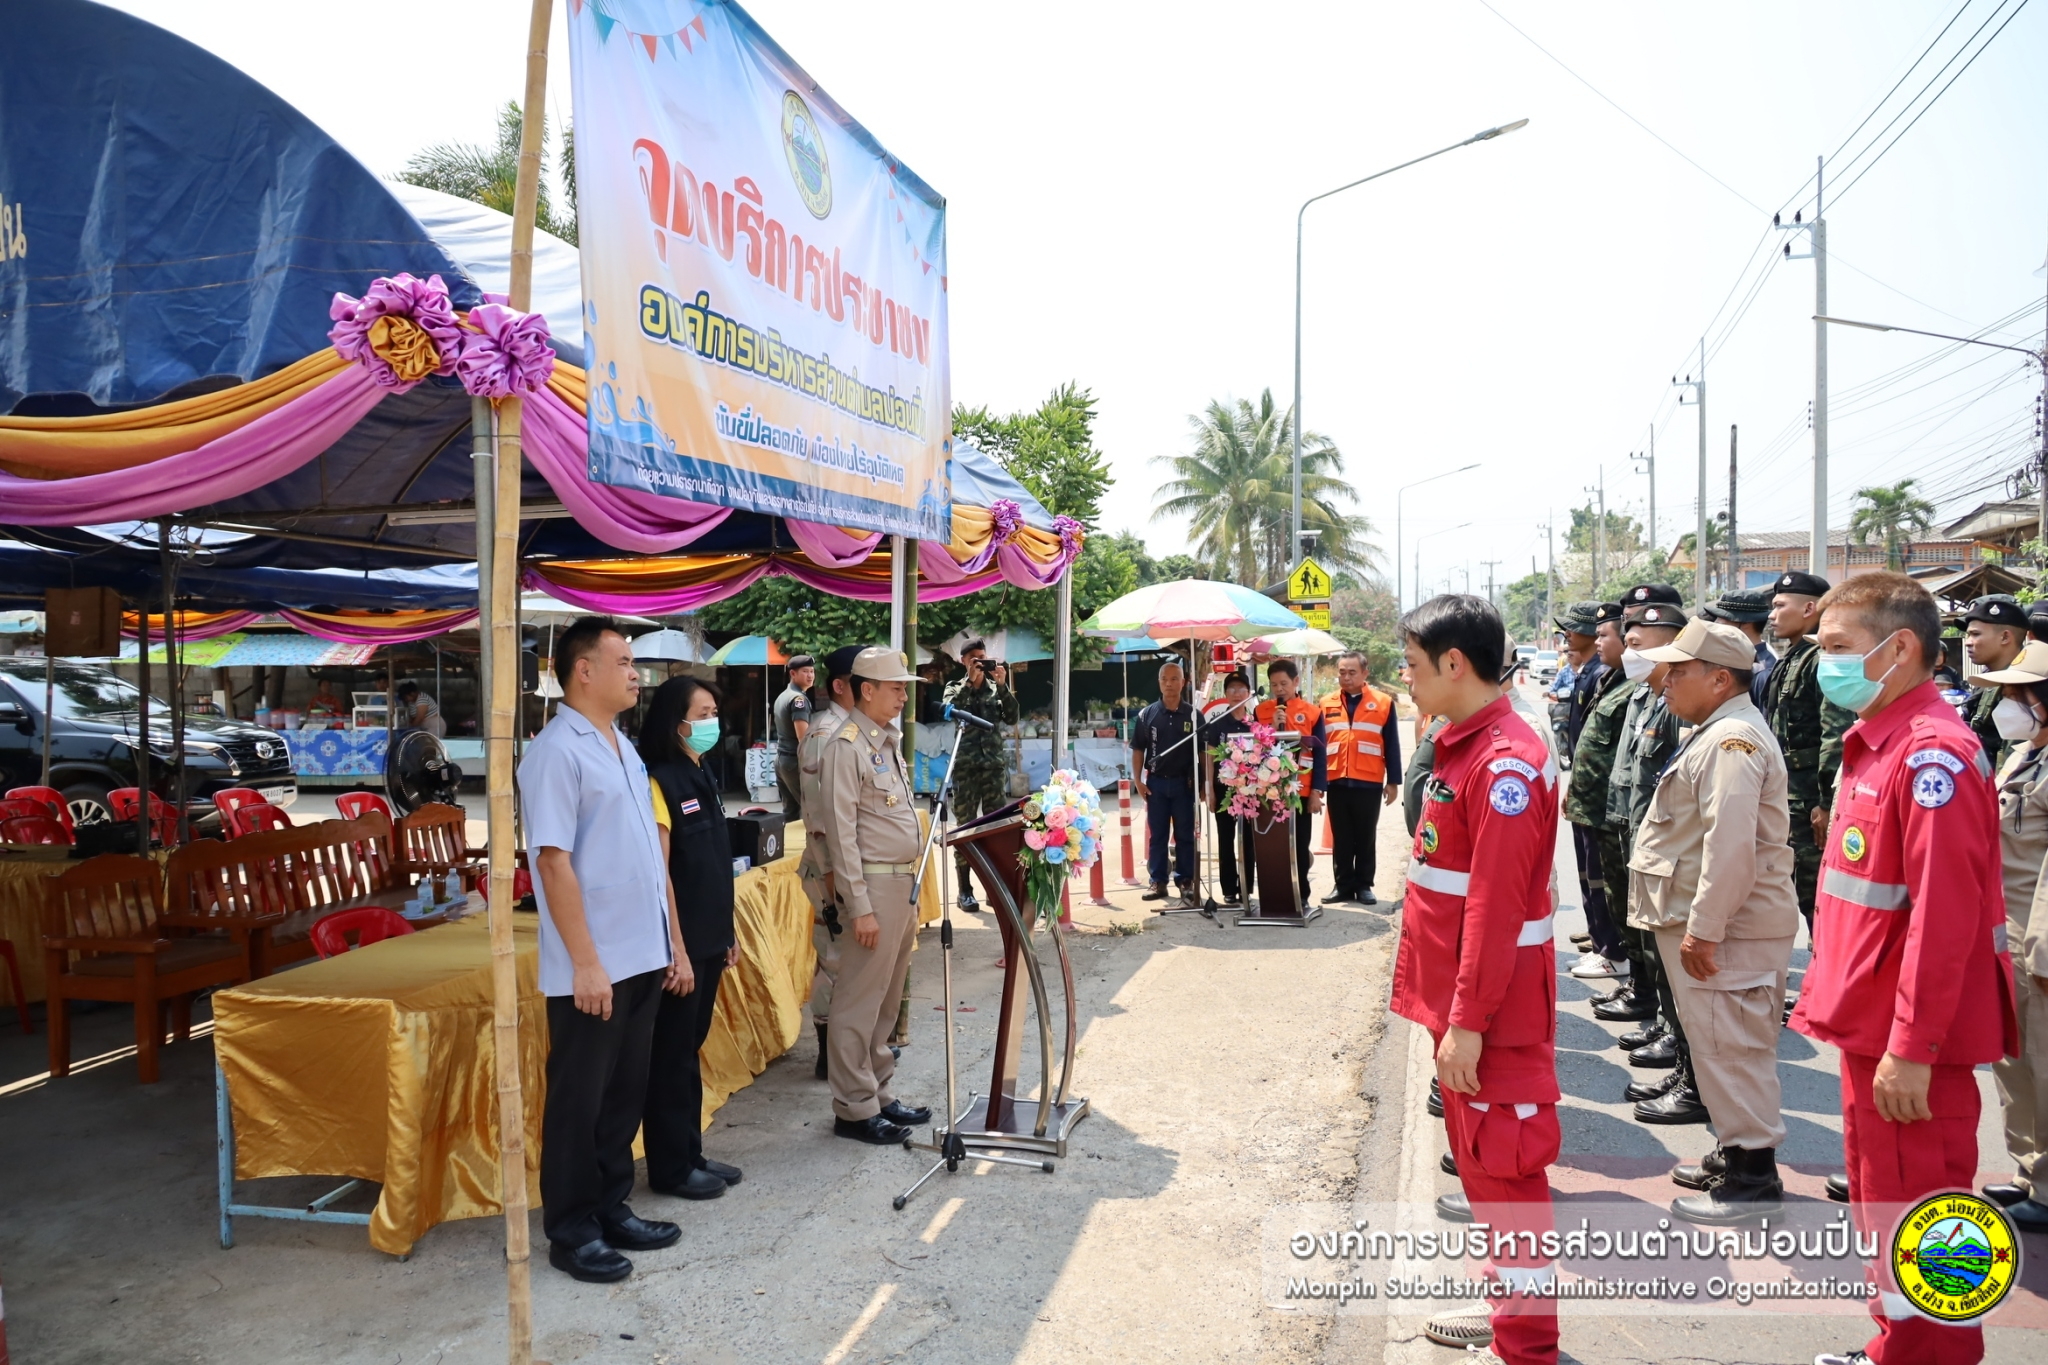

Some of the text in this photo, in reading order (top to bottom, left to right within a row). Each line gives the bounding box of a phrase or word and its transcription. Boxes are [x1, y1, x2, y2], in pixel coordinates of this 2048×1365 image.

[632, 138, 930, 368] จุดบริการประชาชน
[640, 284, 926, 439] องค์การบริหารส่วนตำบลม่อนปิ่น
[716, 402, 904, 488] ขับขี่ปลอดภัย เมืองไทยไร้อุบัติเหตุ
[637, 463, 725, 497] ด้วยความปรารถนาดีจาก
[1495, 758, 1532, 777] RESCUE
[1913, 752, 1957, 769] RESCUE
